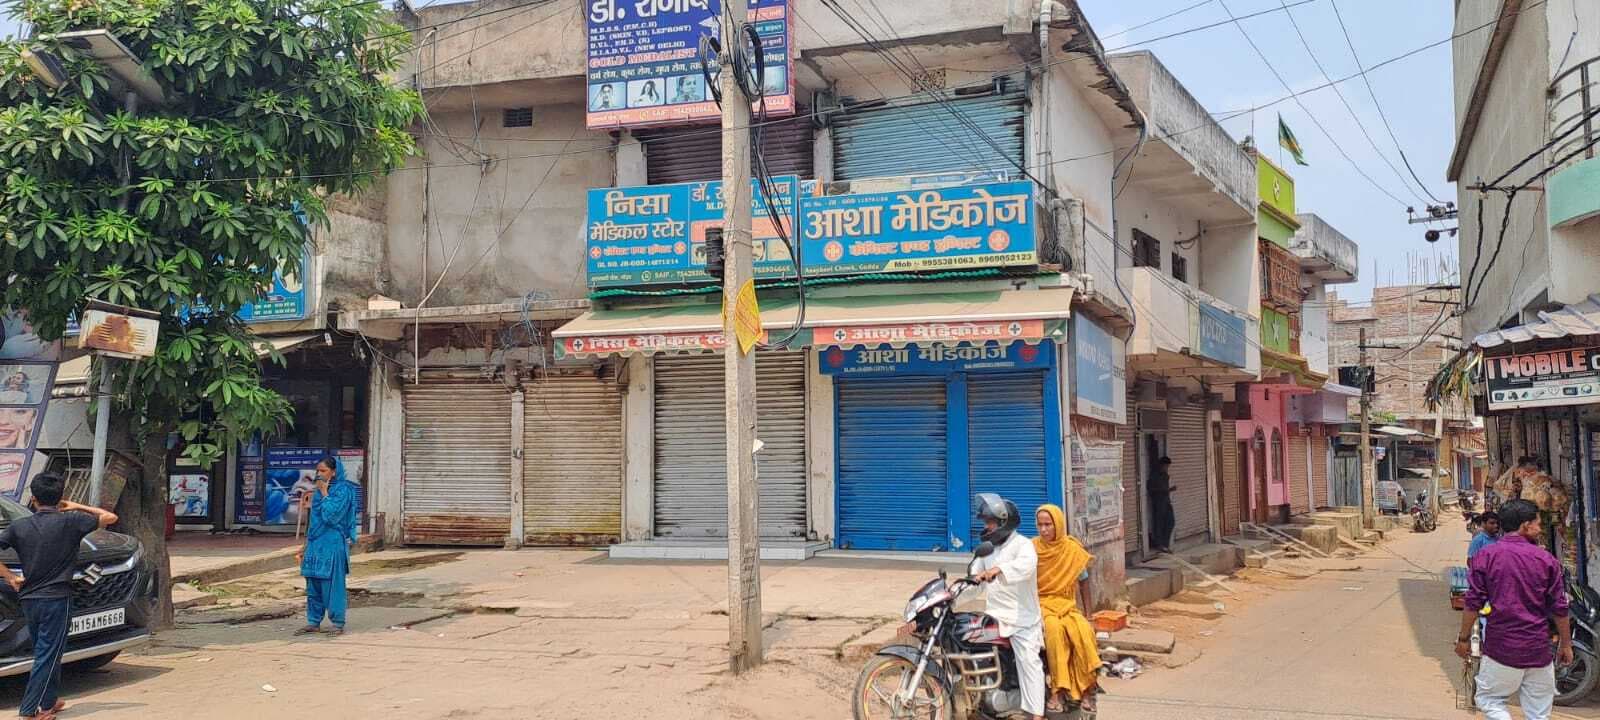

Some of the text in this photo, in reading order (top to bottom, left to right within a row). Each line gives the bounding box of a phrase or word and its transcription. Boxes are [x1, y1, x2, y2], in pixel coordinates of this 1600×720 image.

[605, 191, 671, 217] निसा
[804, 188, 1029, 240] आशा मेडिकोज
[590, 217, 686, 241] मेडिकल स्टोर
[894, 260, 911, 268] Mob
[589, 337, 625, 350] निसा
[634, 334, 700, 350] मेडिकल
[851, 323, 1001, 342] आशा मेडिकोज
[856, 349, 909, 364] आशा
[1500, 348, 1587, 379] MOBILE
